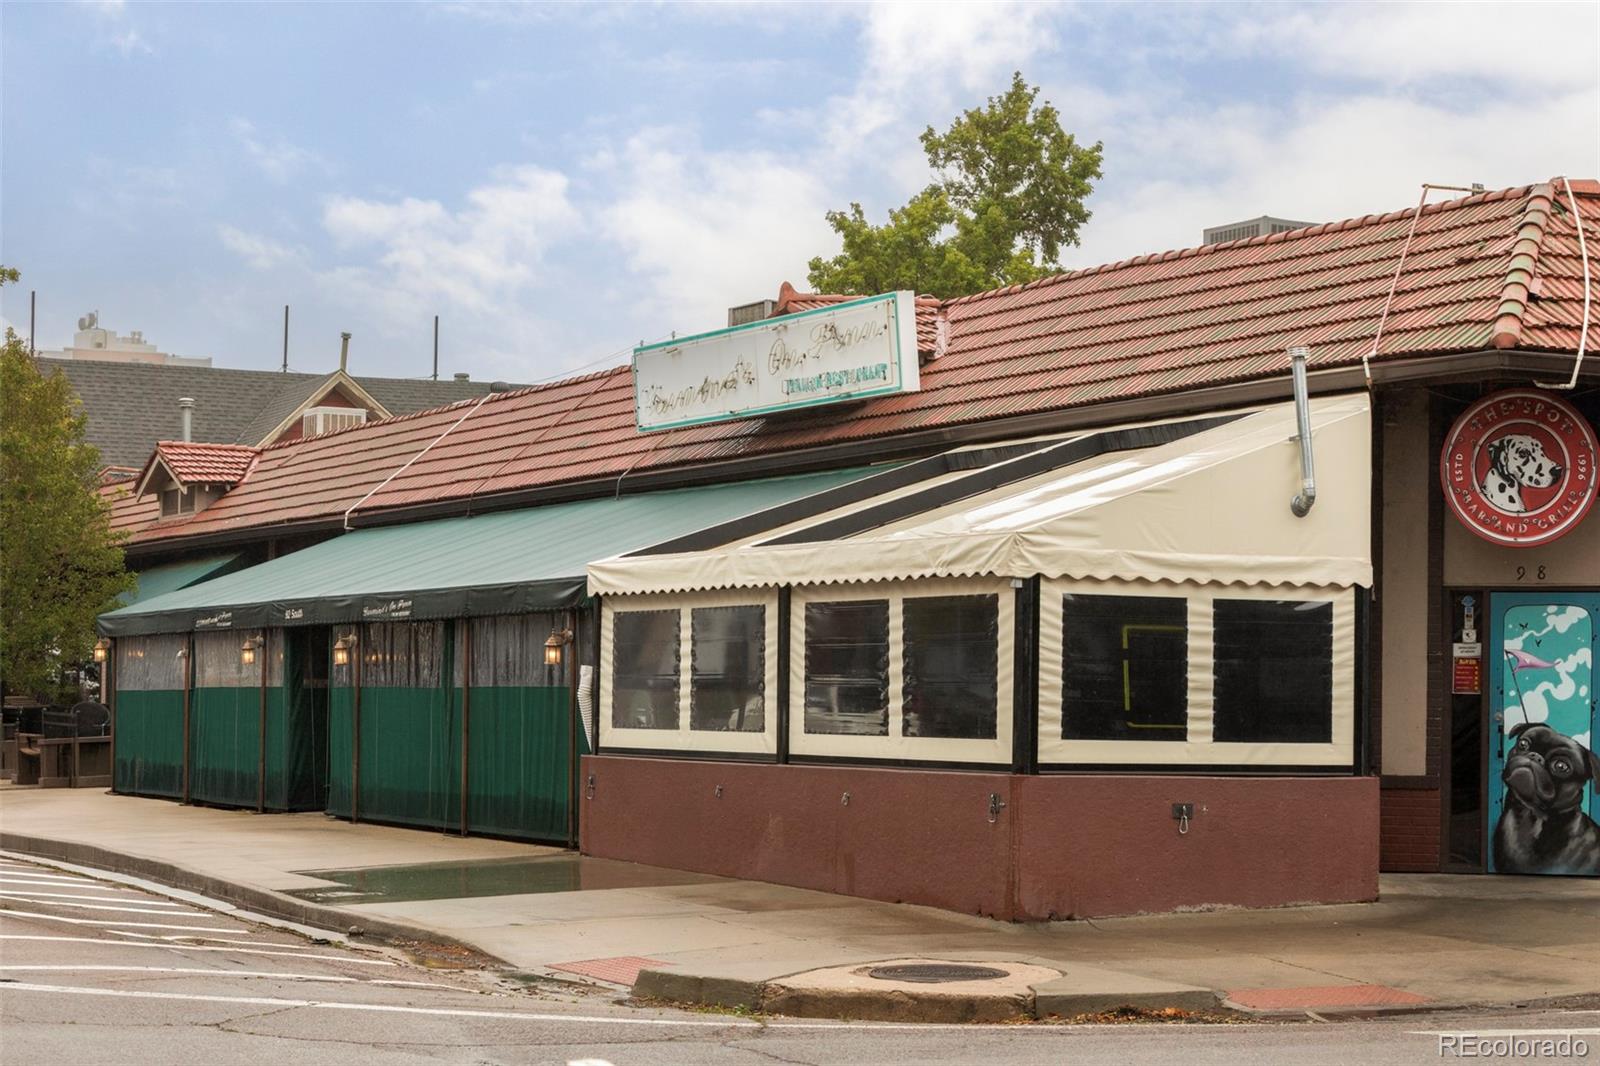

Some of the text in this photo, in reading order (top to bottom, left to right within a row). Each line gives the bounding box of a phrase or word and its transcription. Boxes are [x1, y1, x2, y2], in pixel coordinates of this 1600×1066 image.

[1470, 401, 1573, 432] THE SPOT
[1455, 453, 1464, 482] ESTD
[1577, 454, 1587, 481] 1996
[1463, 492, 1578, 533] BAR AND GRILL
